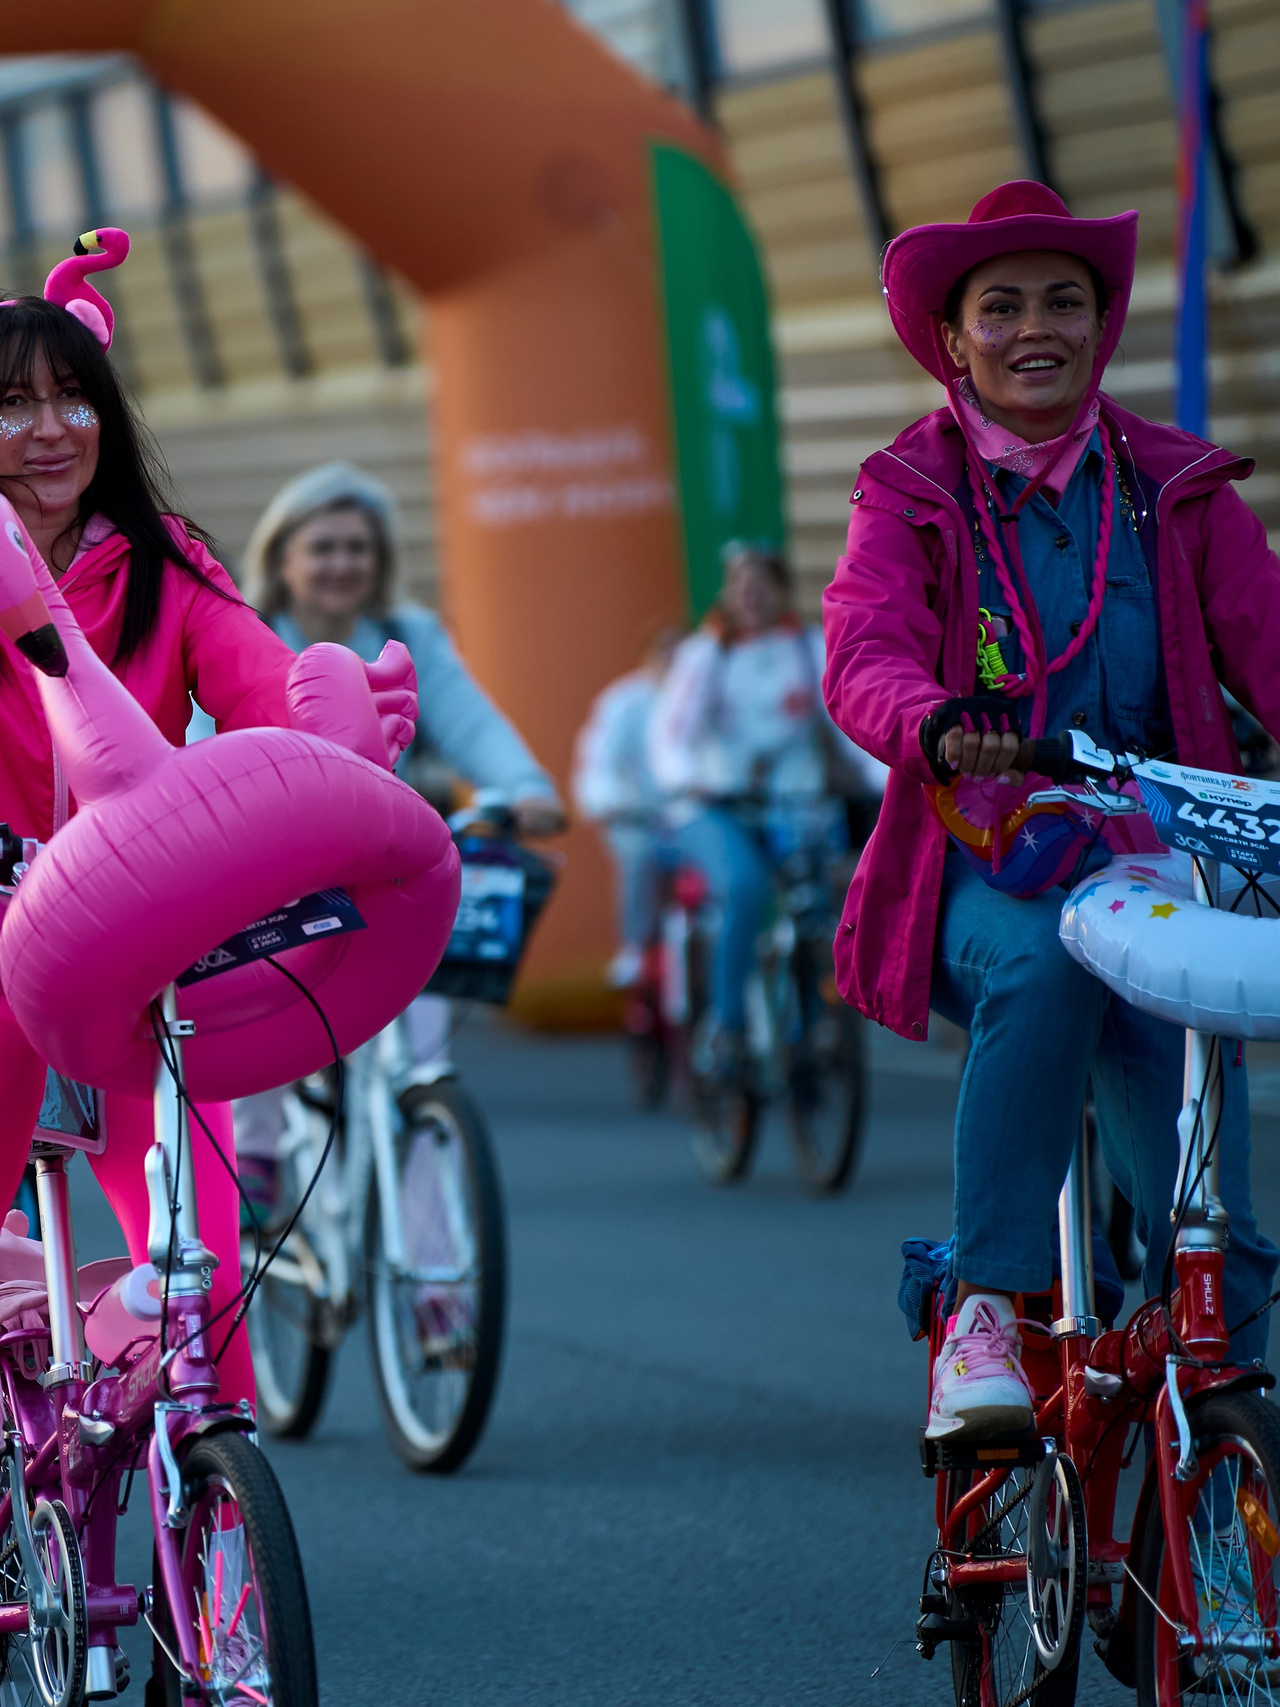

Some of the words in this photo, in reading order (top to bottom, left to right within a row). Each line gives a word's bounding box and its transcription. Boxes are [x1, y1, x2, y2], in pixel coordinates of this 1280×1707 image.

[1180, 771, 1232, 789] фонтанка.ру
[1177, 802, 1280, 844] 4432
[251, 931, 277, 944] СТАРТ
[1203, 1273, 1214, 1315] SHULZ
